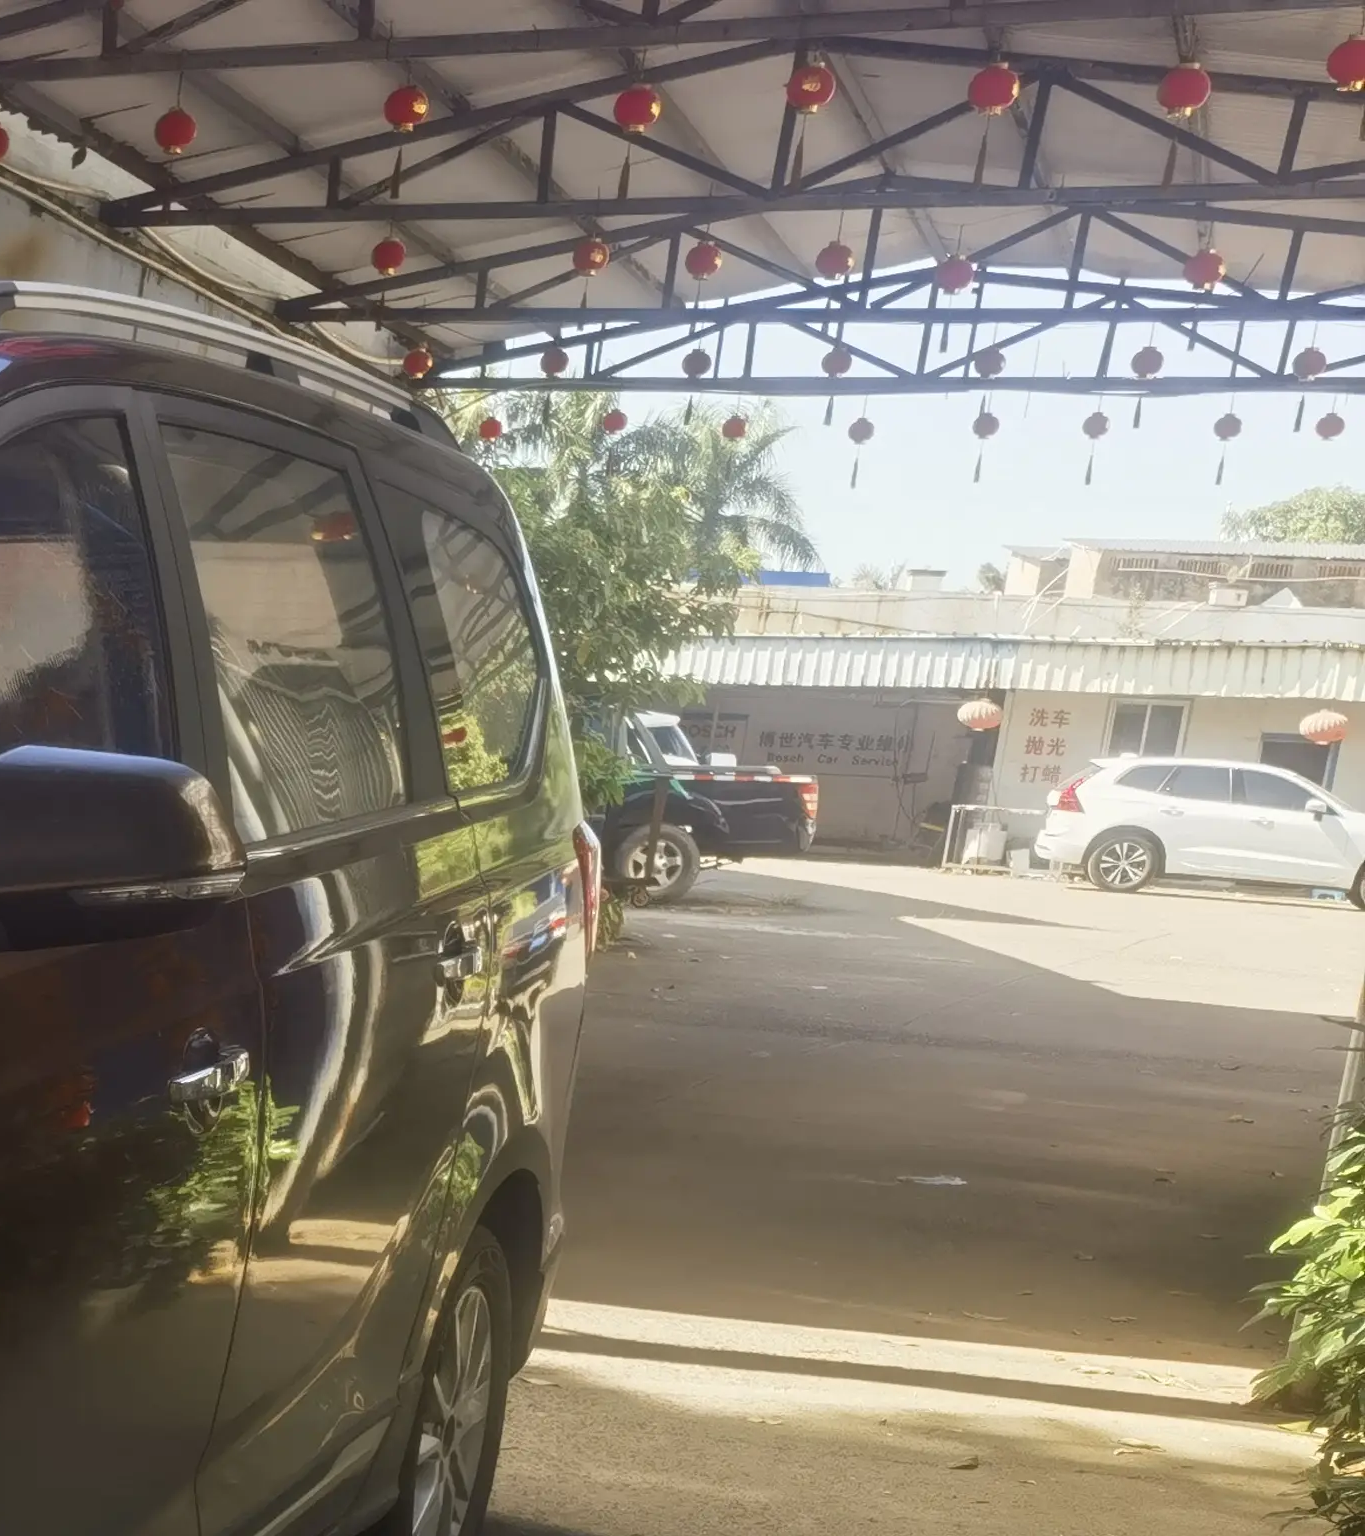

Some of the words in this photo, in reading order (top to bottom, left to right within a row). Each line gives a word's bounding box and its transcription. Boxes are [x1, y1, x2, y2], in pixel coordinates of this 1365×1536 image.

[1029, 708, 1071, 728] 洗车
[1024, 735, 1066, 757] 抛光
[817, 753, 839, 765] Car
[1019, 764, 1062, 785] 打蜡
